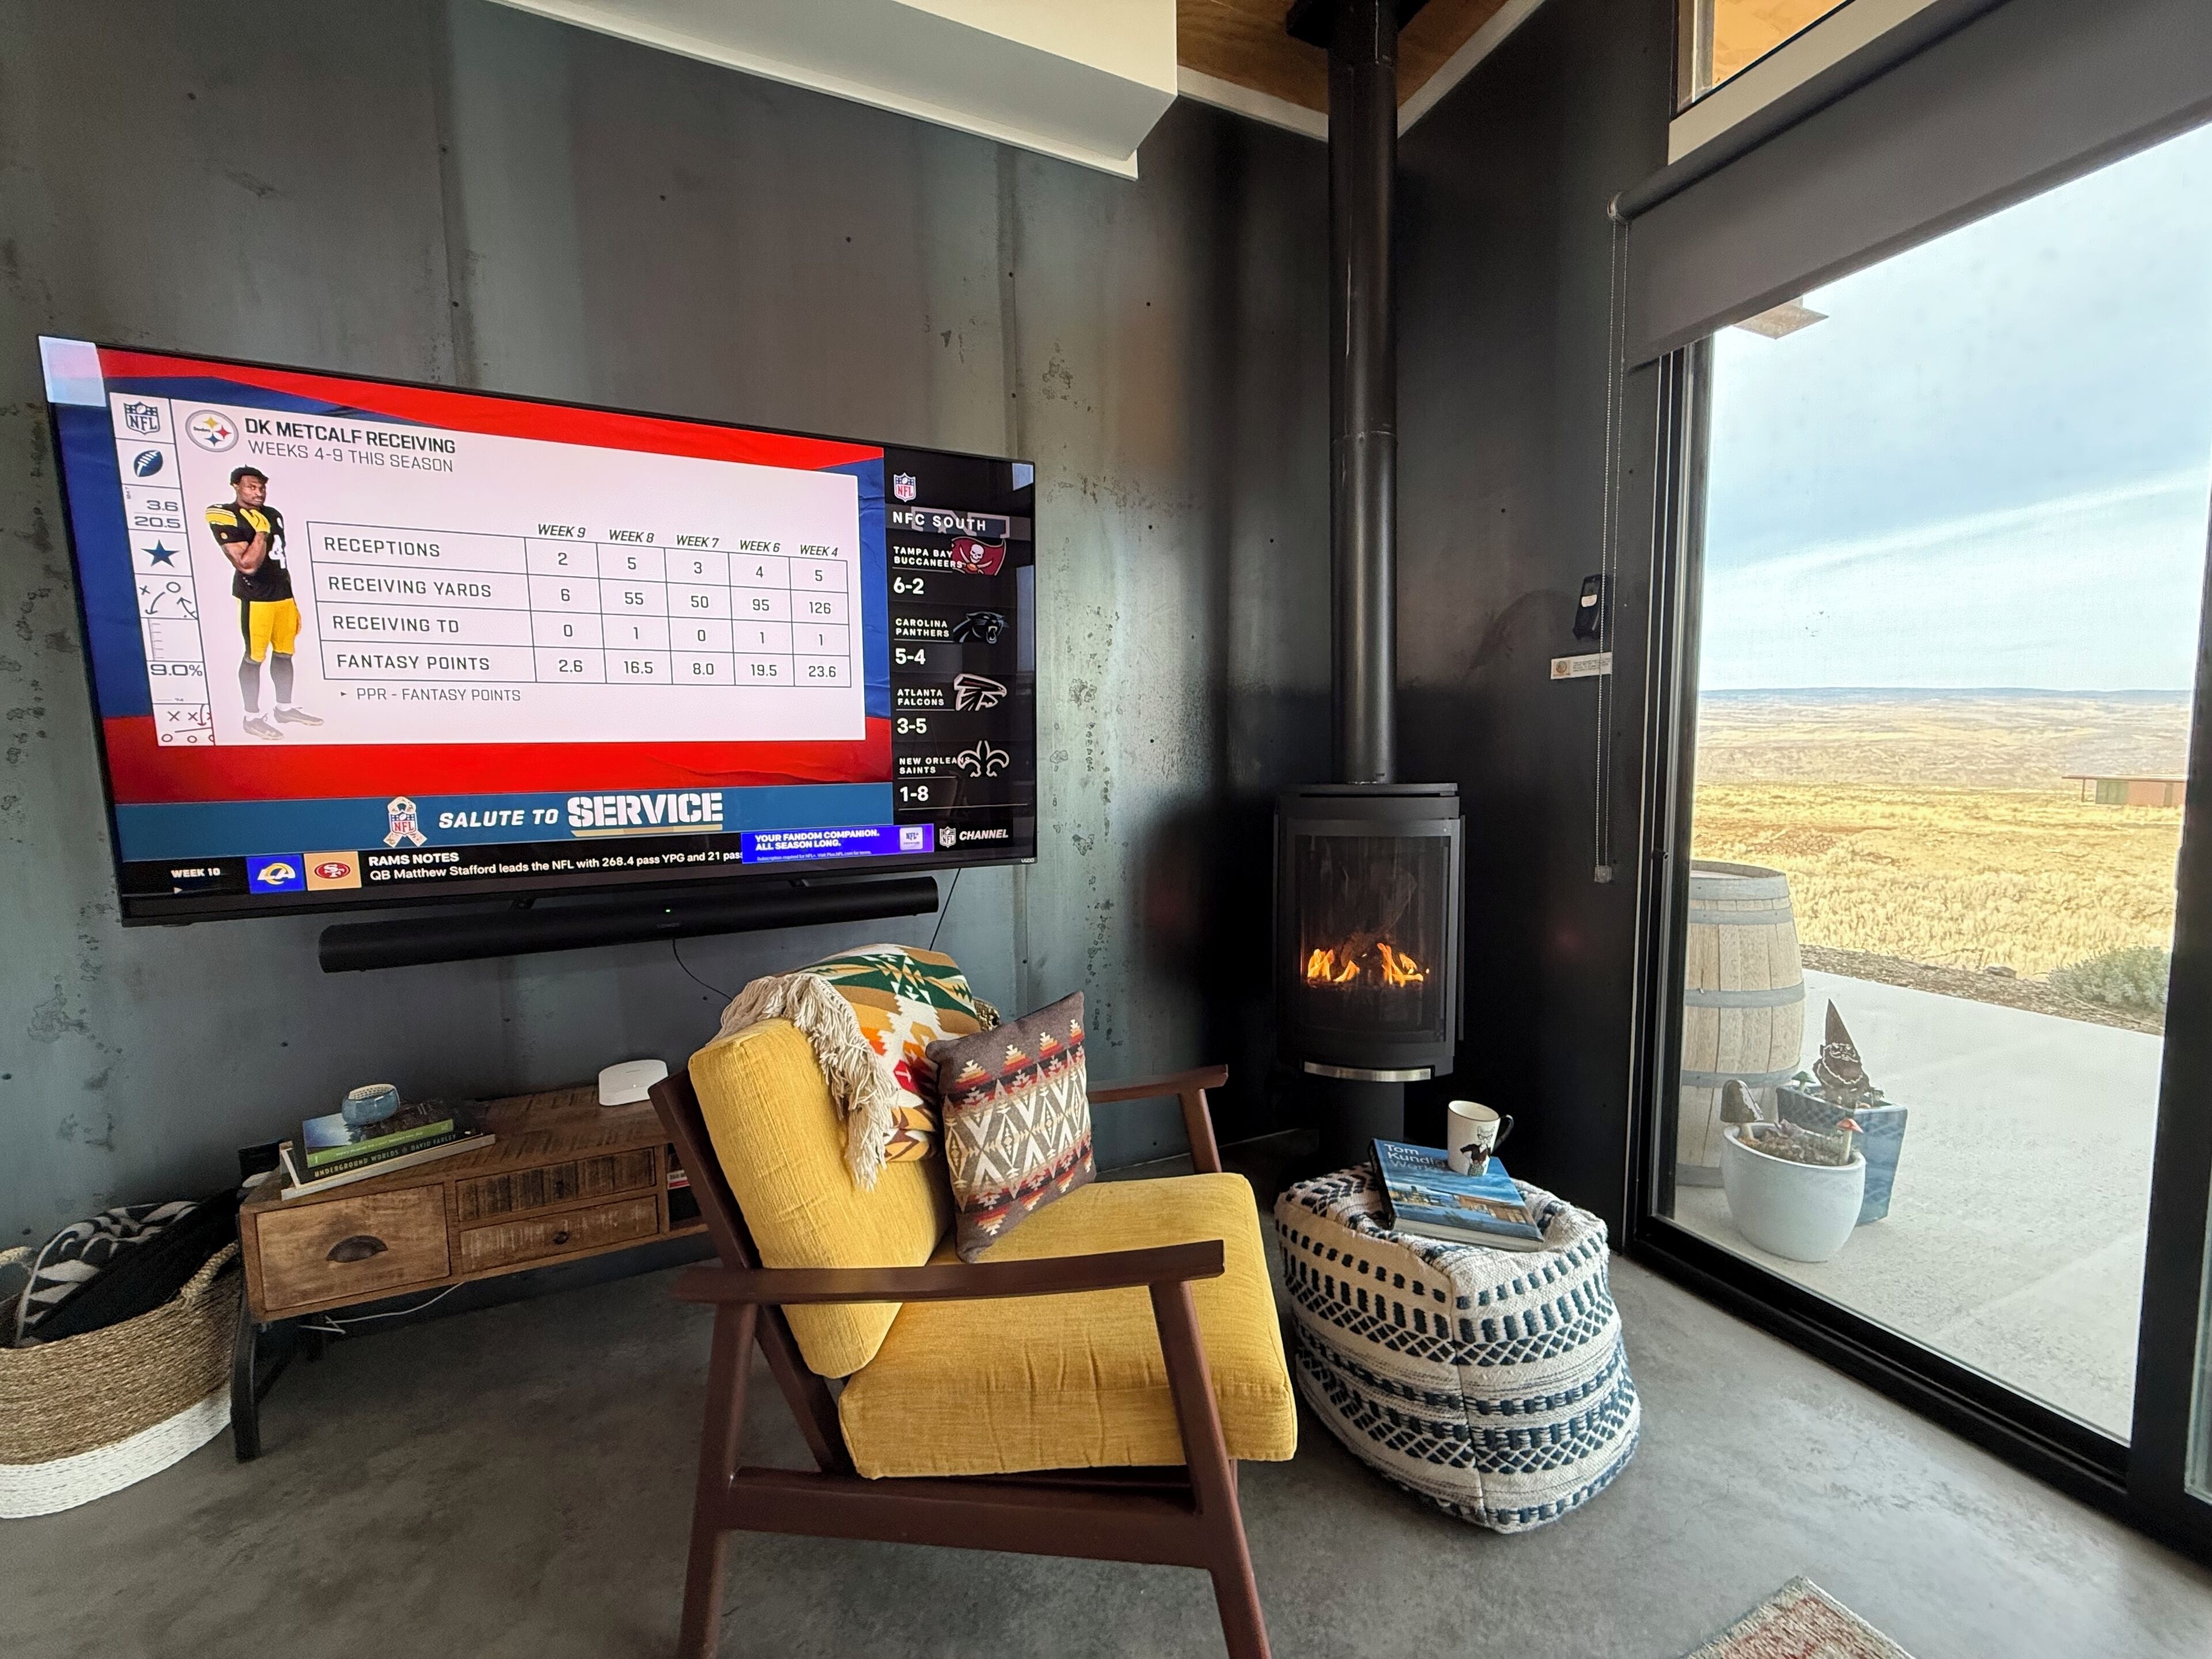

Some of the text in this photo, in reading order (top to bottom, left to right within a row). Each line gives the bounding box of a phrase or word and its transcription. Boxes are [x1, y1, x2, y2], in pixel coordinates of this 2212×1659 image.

[129, 415, 157, 431] NFL
[245, 418, 456, 454] DK METCALF RECEIVING
[248, 440, 453, 472] WEEKS 4-9 THIS SEASON
[897, 485, 913, 497] NFL
[146, 500, 178, 512] 3.6
[134, 516, 180, 529] 20.5
[893, 512, 986, 531] NFC SOUTH
[538, 524, 586, 538] WEEK 9
[609, 529, 654, 543] WEEK 8
[677, 535, 719, 548] WEEK 7
[740, 540, 781, 552] WEEK 6
[800, 544, 838, 556] WEEK 4
[893, 546, 953, 558] TAMPA BAY
[324, 536, 823, 581] RECEPTIONS 2 5 3 4 5
[894, 556, 963, 569] BUCCANEERS
[893, 577, 924, 594] 6-2
[328, 576, 831, 614] RECEIVING YARDS 6 55 50 95 126
[895, 618, 948, 628] CAROLINA
[332, 615, 823, 646] RECEIVING TD 0 1 0 1 1
[896, 627, 949, 638] PANTHERS
[895, 647, 926, 665] 5-4
[150, 664, 203, 676] 9.0%
[337, 654, 836, 677] FANTASY POINTS 2.6 16.5 8.0 19.5 23.6
[357, 688, 387, 700] PPR
[402, 688, 466, 700] FANTASY
[472, 689, 521, 701] POINTS
[897, 688, 943, 697] ATLANTA
[897, 698, 945, 706] FALCONS
[897, 718, 927, 734] 3-5
[926, 757, 971, 765] ORLEANS
[899, 766, 936, 774] SAINTS
[900, 786, 929, 802] 1-8
[439, 792, 723, 828] SALUTE TO SERVICE
[395, 821, 414, 832] NFL
[755, 829, 880, 843] YOUR FANDOM COMPANION.
[959, 829, 1009, 841] CHANNEL
[755, 839, 841, 851] ALL SEASON LONG.
[369, 853, 459, 866] RAMS NOTES
[370, 870, 391, 880] QB
[394, 868, 446, 879] Matthew
[449, 864, 496, 876] Stafford
[499, 862, 529, 873] leads
[531, 861, 549, 871] the
[552, 860, 574, 870] NFL
[576, 858, 600, 869] with
[602, 856, 634, 868] 268.4
[636, 855, 660, 867] pass
[662, 854, 685, 863] YPG
[687, 852, 706, 862] and
[707, 851, 719, 861] 21
[171, 868, 220, 878] WEEK 10
[1384, 1143, 1419, 1156] Tom
[314, 1158, 368, 1177] UNDERGROUND
[371, 1149, 399, 1161] WORLDS
[411, 1141, 431, 1151] DAVID
